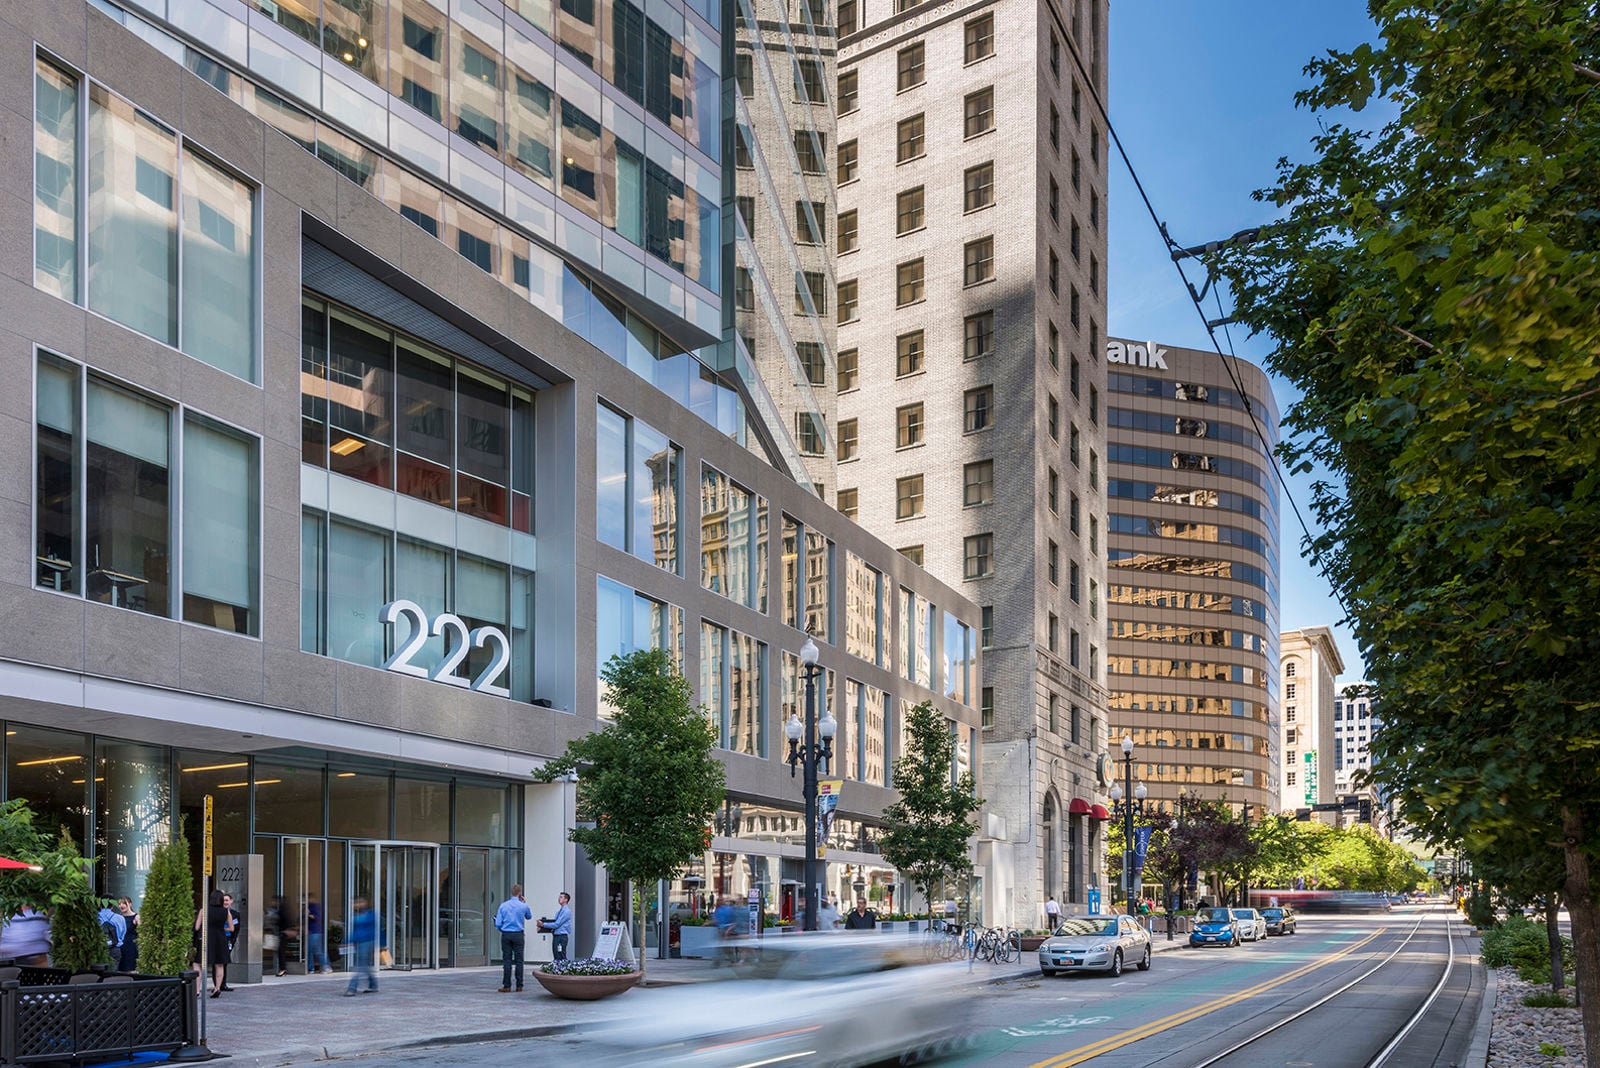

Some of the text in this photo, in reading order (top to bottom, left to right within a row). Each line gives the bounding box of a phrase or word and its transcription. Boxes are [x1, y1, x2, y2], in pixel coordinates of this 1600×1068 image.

[1107, 341, 1168, 370] ank
[379, 600, 510, 698] 222
[222, 867, 240, 881] 222
